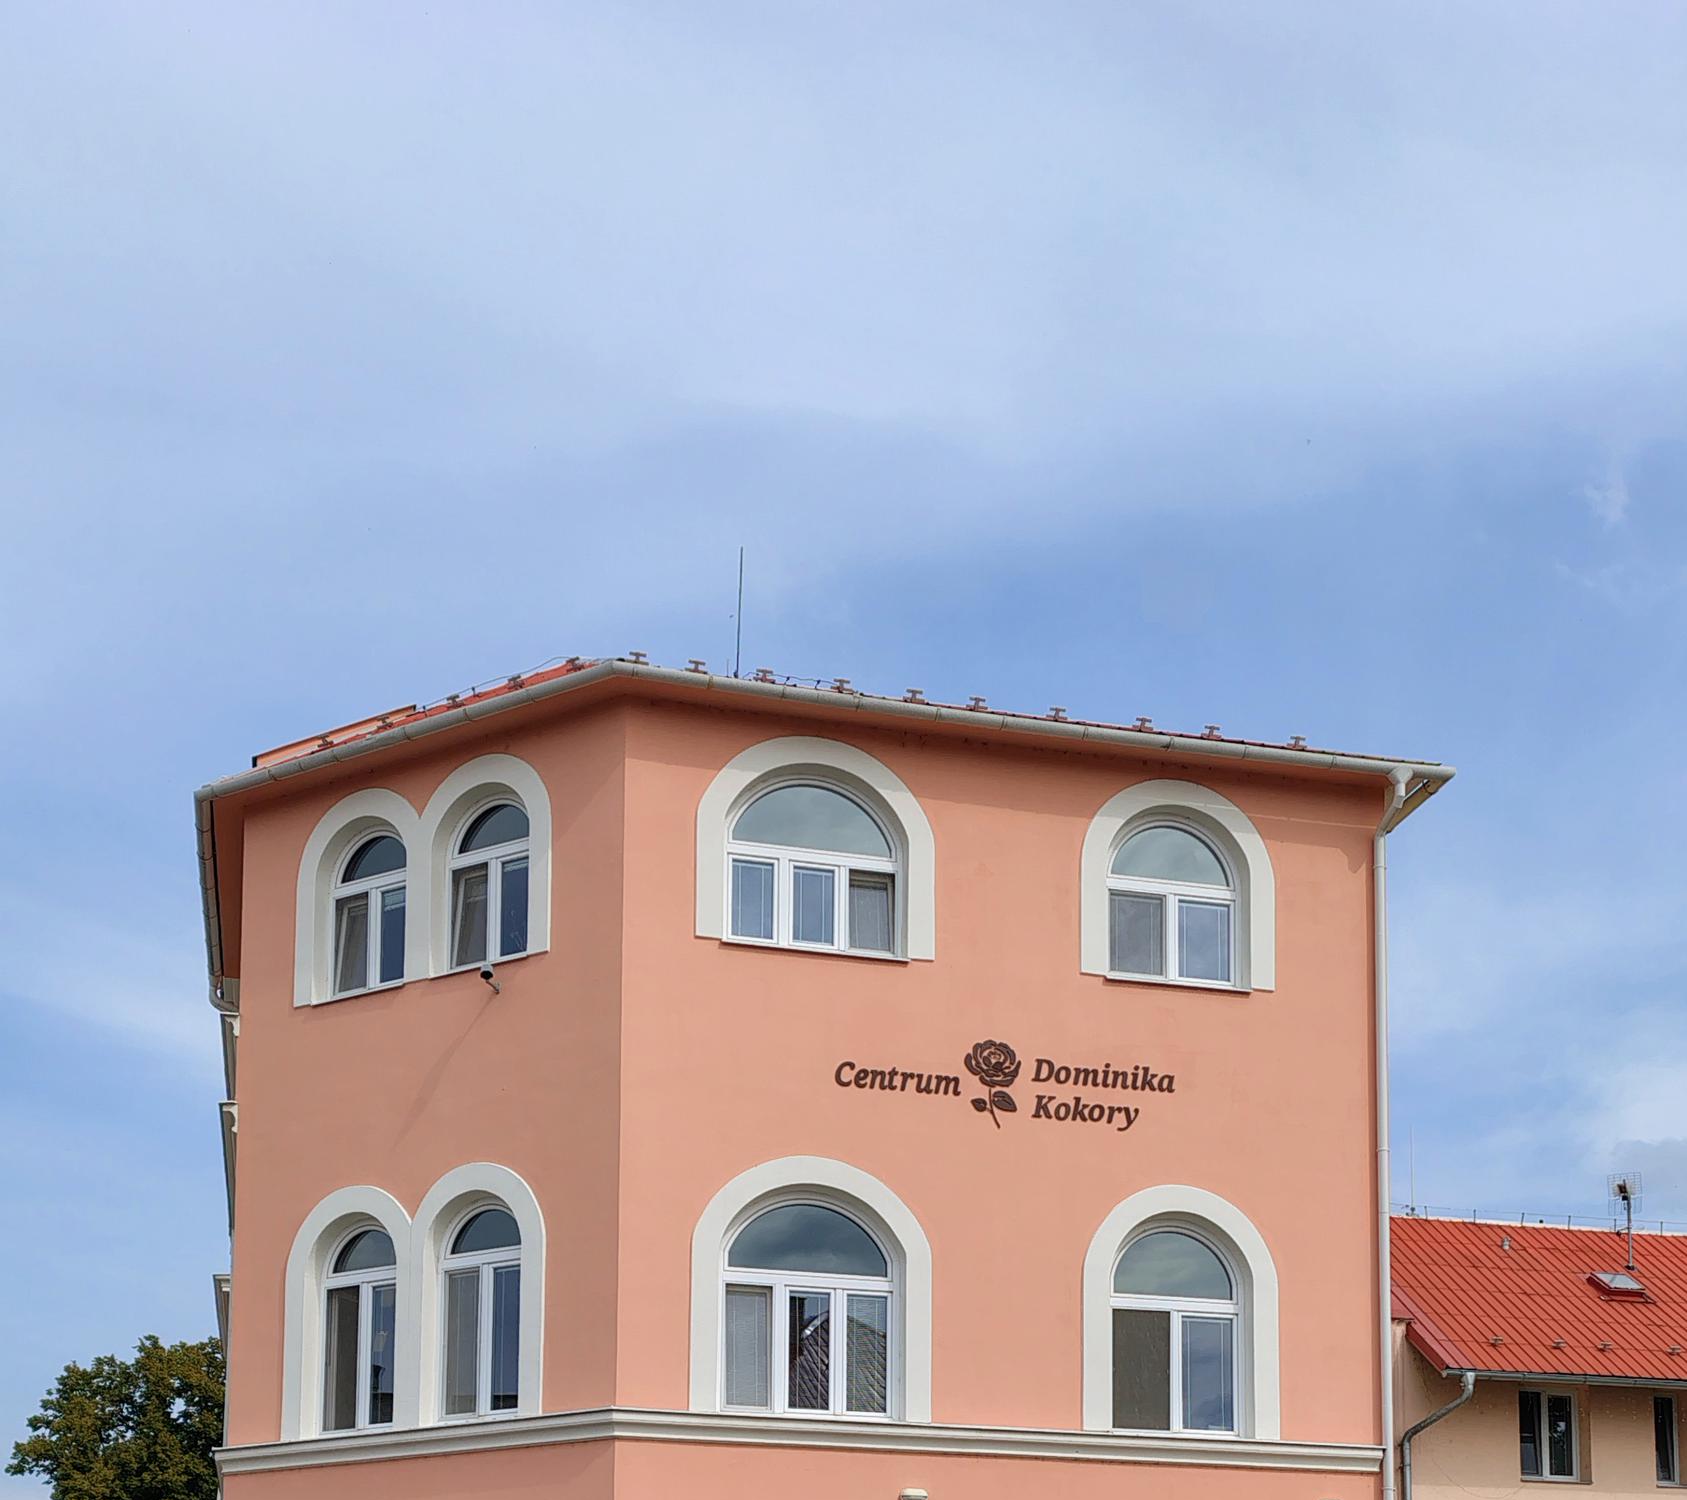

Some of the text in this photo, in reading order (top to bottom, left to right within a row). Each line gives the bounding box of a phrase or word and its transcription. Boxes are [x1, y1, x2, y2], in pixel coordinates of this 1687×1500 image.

[834, 1058, 1176, 1097] Centrum Dominika
[1030, 1094, 1140, 1132] Kokory
